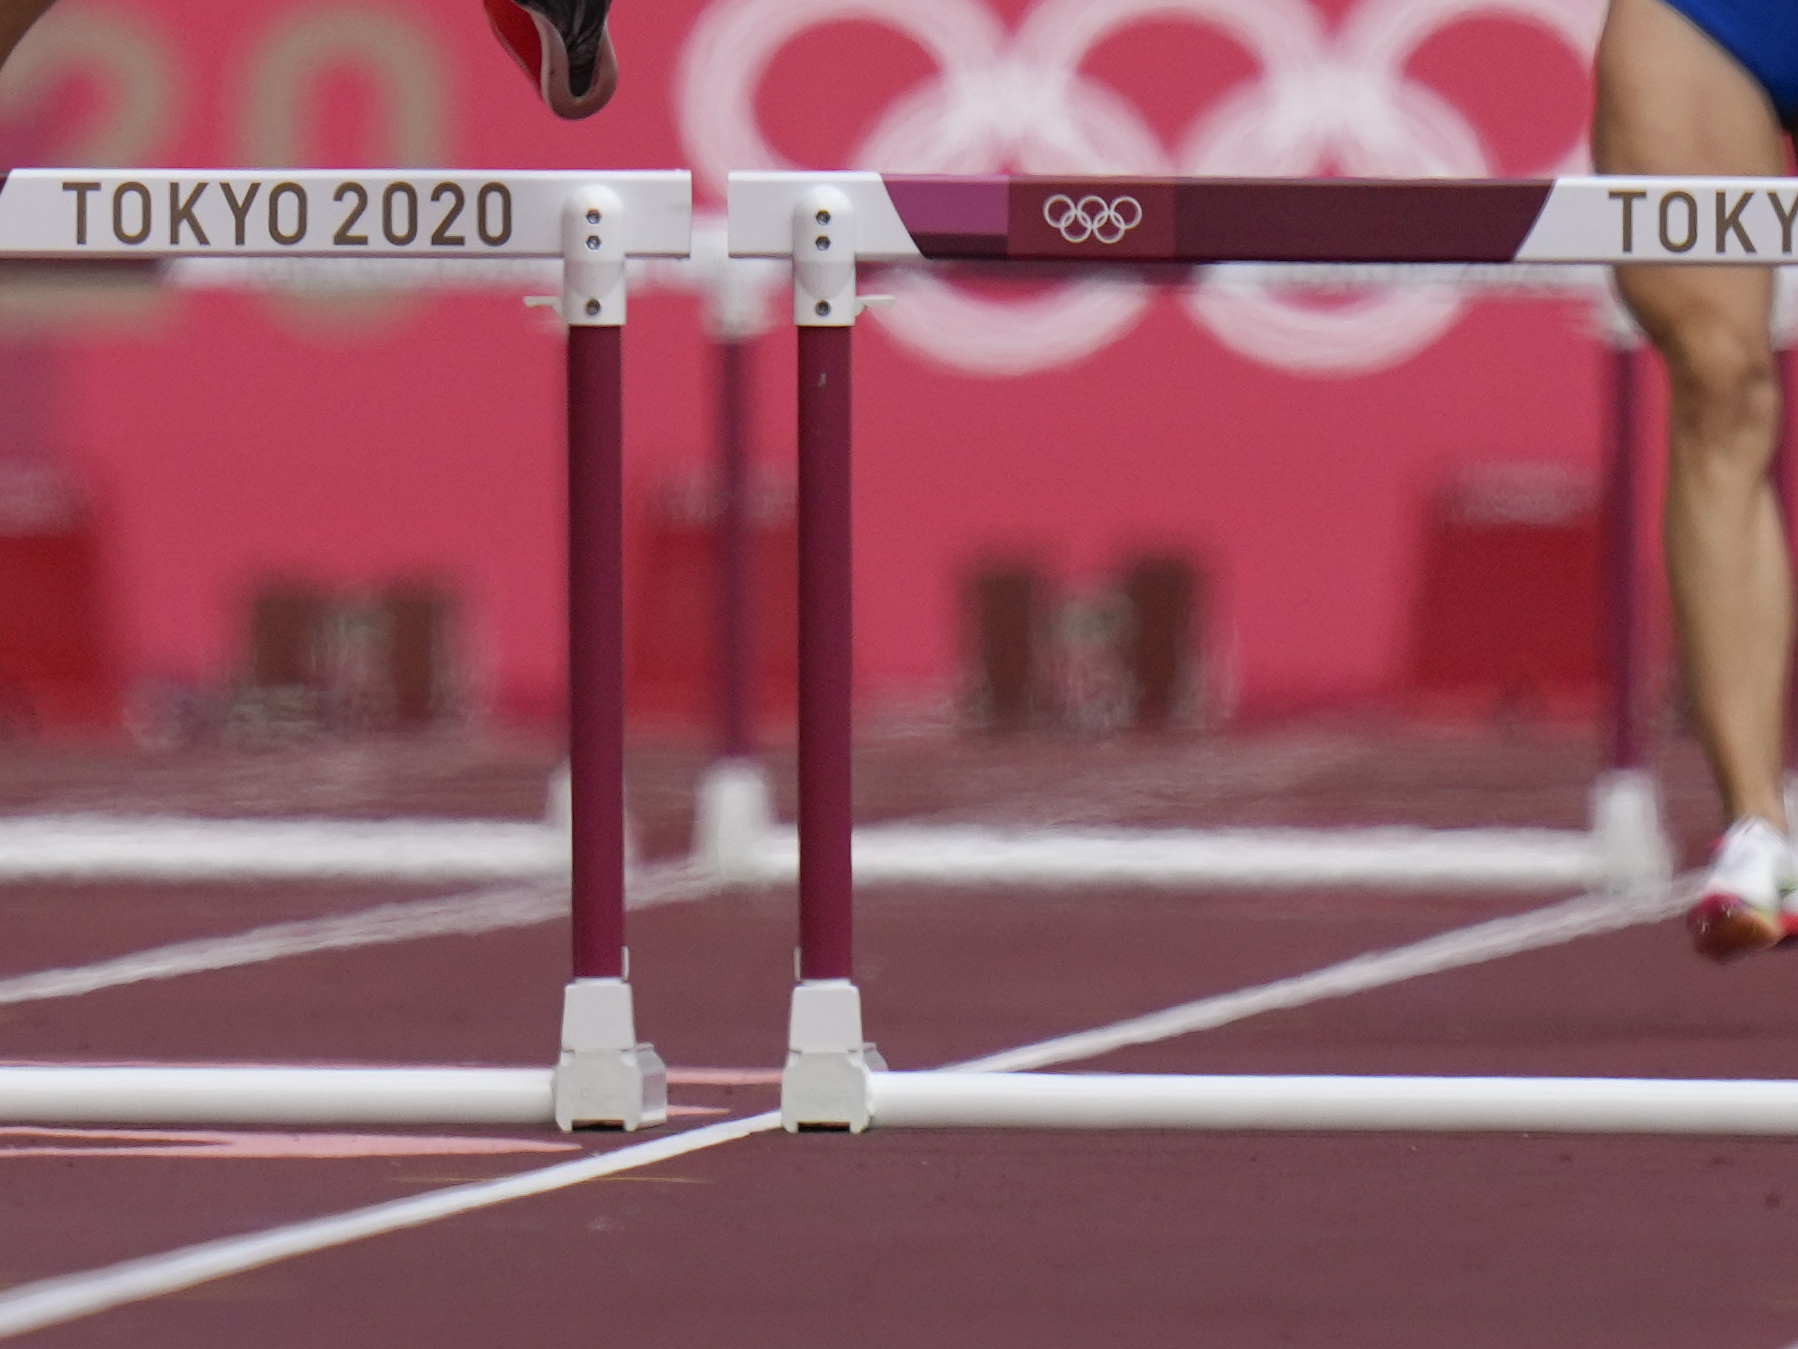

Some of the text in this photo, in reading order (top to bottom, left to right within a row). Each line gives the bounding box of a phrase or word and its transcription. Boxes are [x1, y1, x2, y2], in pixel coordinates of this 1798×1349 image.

[61, 180, 513, 248] TOKYO 2020
[1607, 190, 1798, 255] TOKY
